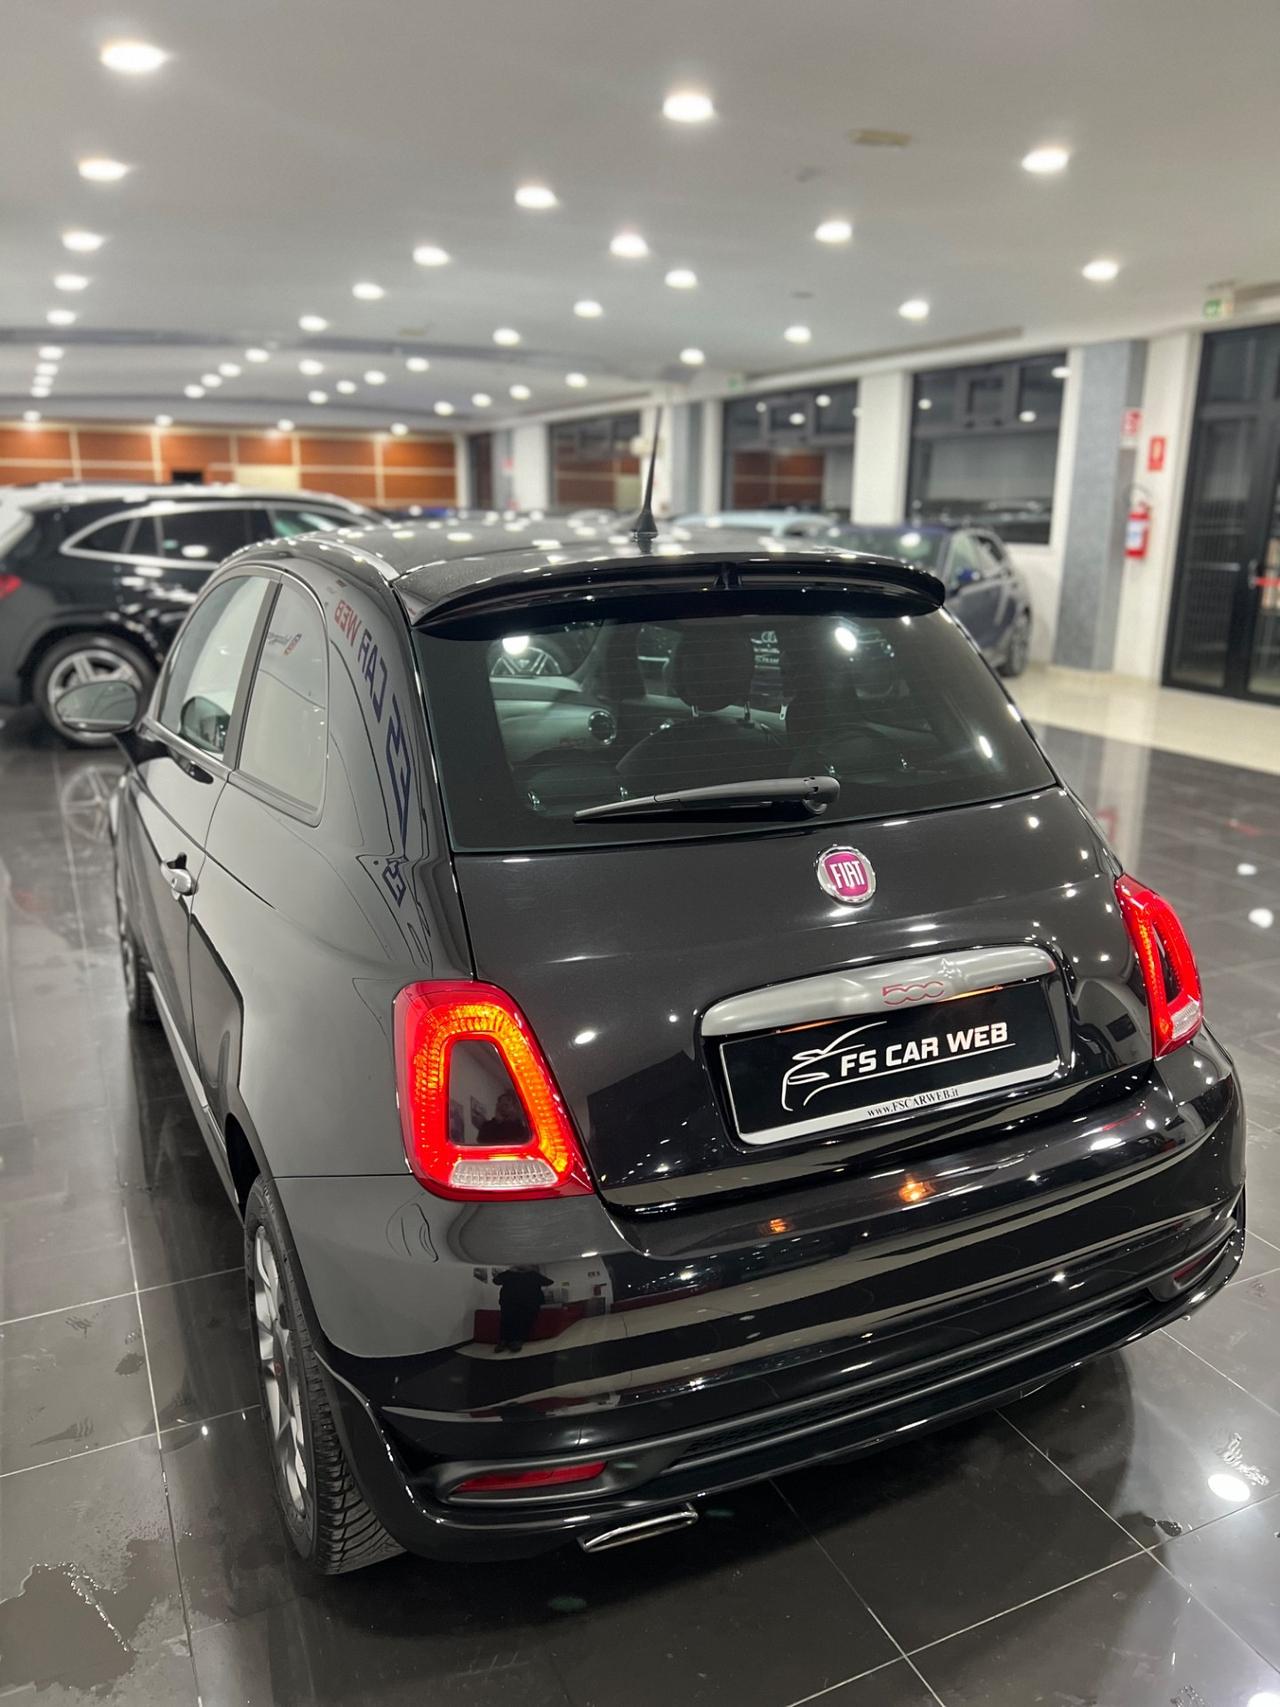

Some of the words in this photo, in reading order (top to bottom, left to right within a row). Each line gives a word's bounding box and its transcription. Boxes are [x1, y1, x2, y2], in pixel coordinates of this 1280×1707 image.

[829, 860, 865, 889] FIAT
[882, 981, 945, 1005] 500
[840, 1049, 878, 1078] FS
[885, 1036, 939, 1067] CAR
[946, 1021, 1008, 1053] WEB
